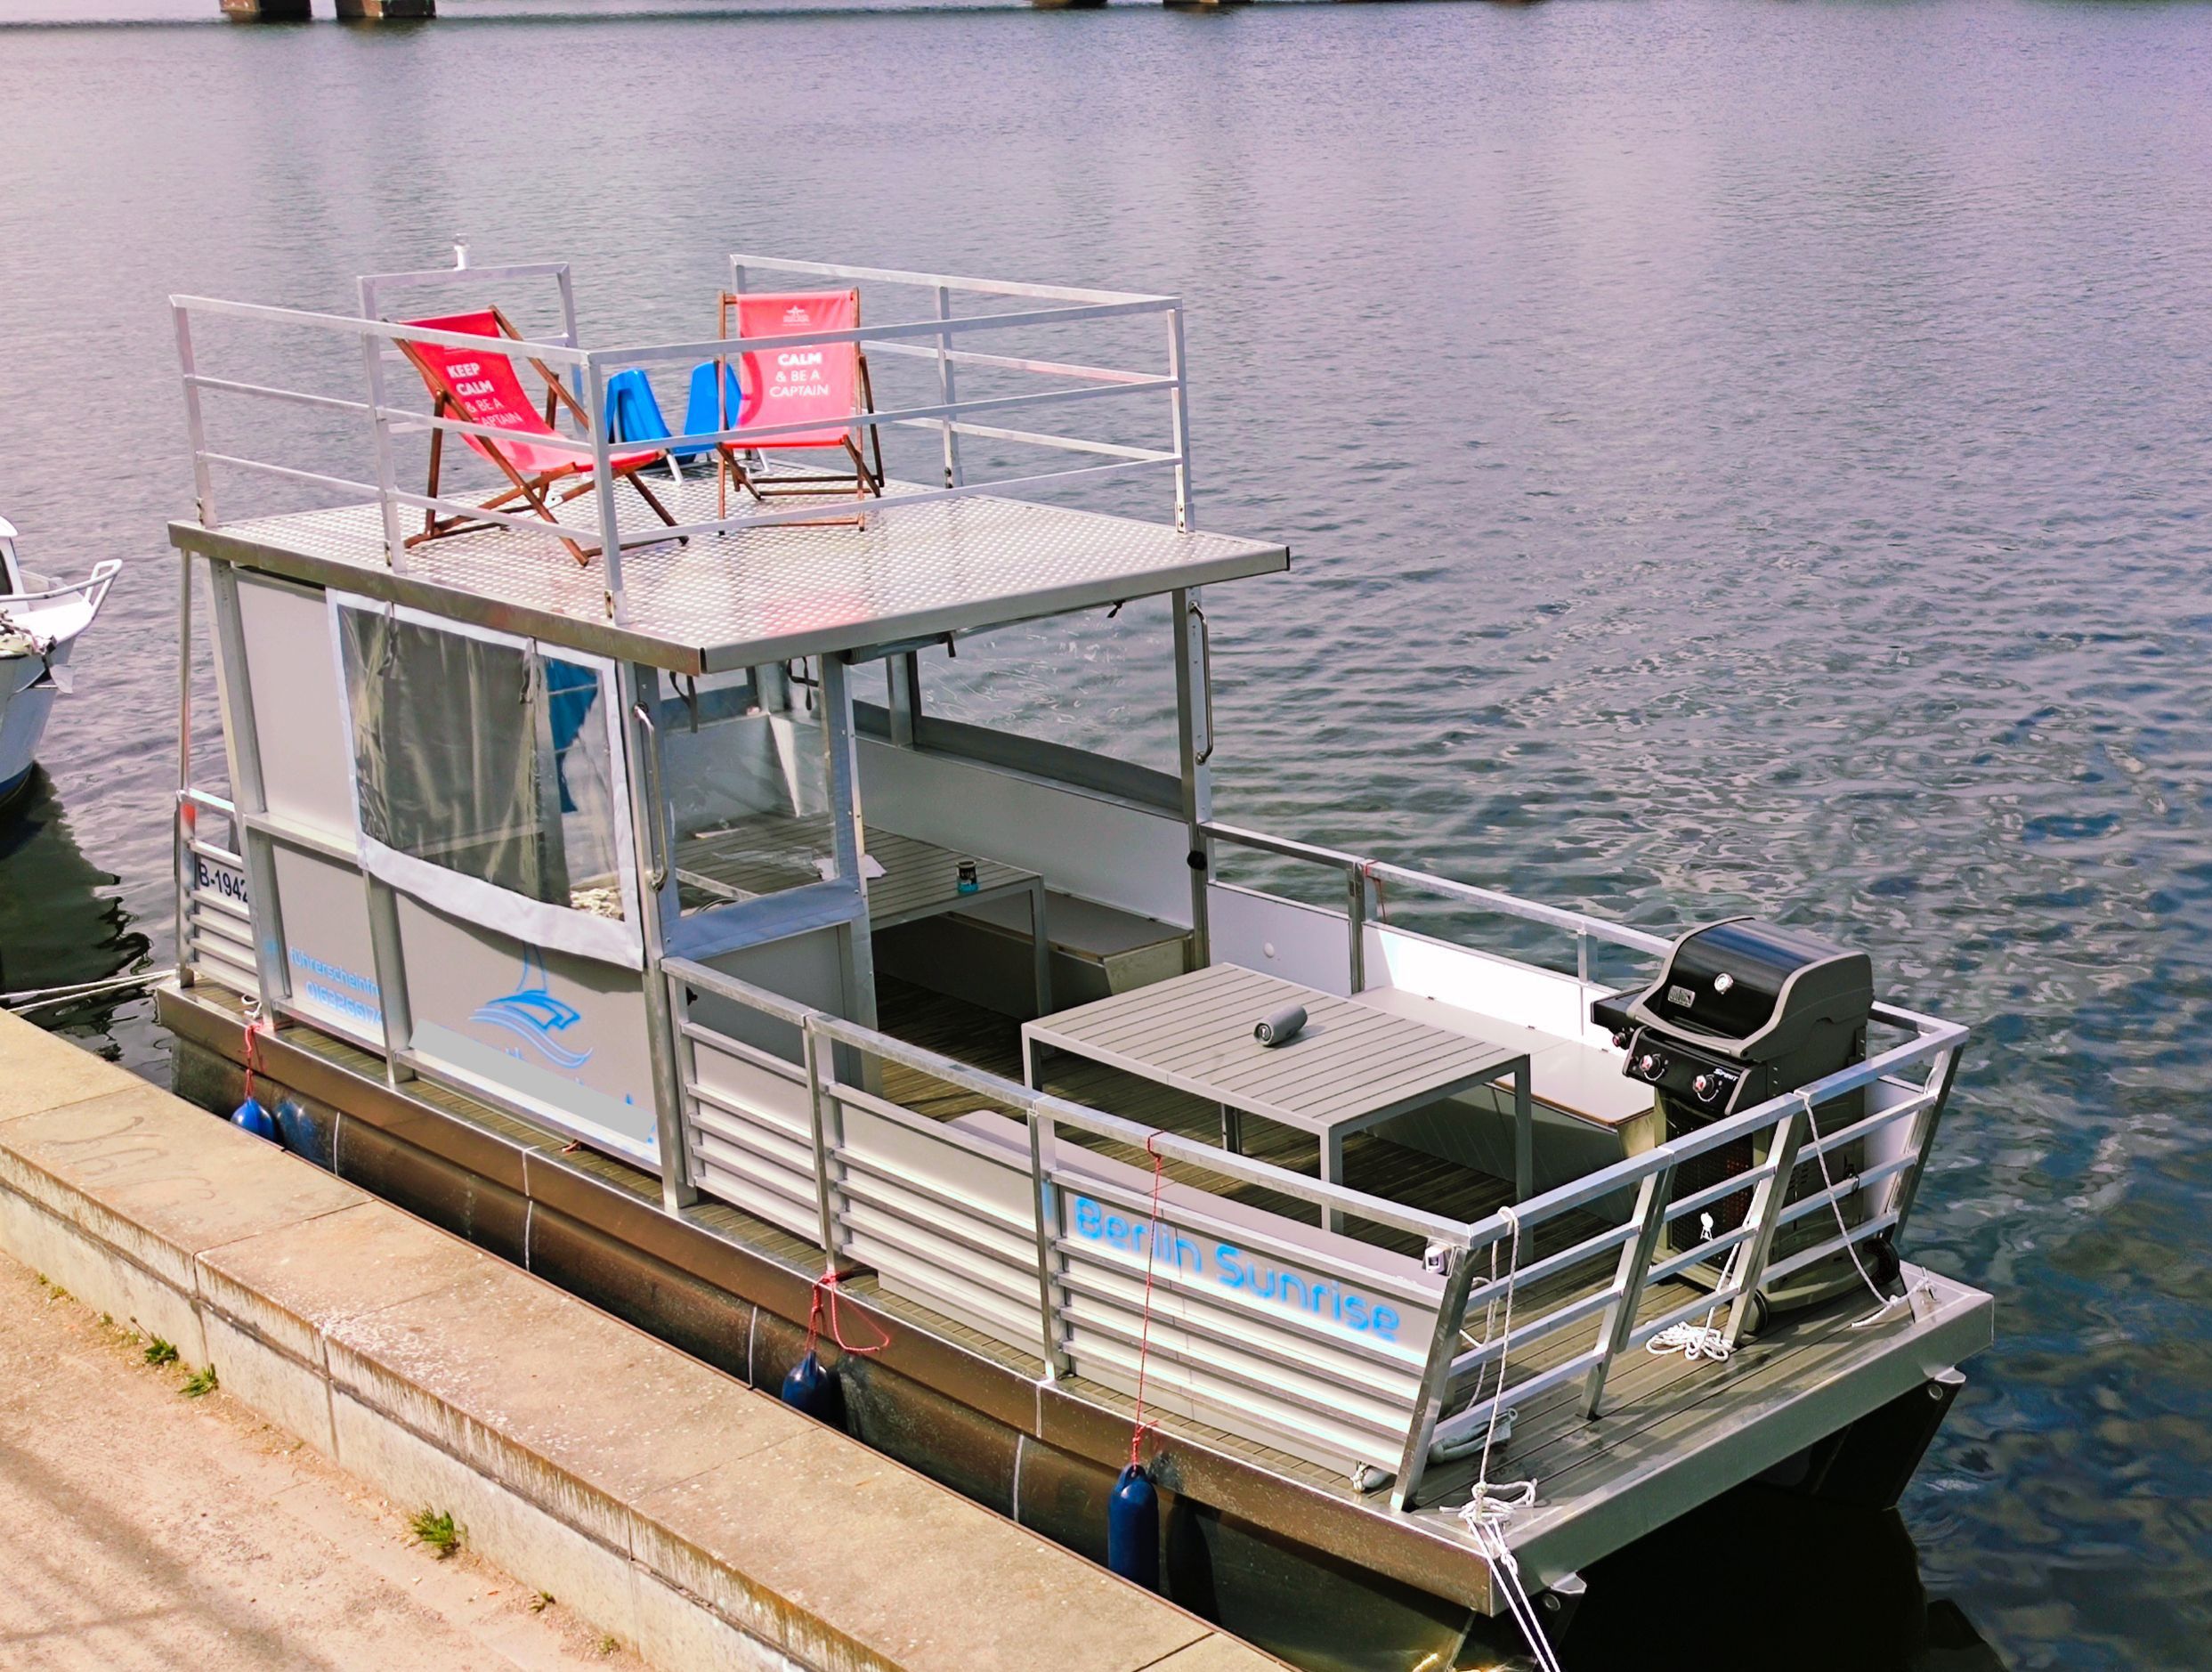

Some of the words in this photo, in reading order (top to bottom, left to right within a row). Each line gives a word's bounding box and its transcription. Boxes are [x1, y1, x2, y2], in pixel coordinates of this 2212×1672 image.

[777, 352, 822, 366] CALM
[446, 362, 480, 378] KEEP
[775, 370, 786, 382] &
[790, 369, 806, 382] BE
[810, 369, 821, 380] A
[456, 380, 494, 396] CALM
[769, 384, 830, 397] CAPTAIN
[465, 401, 477, 413] &
[474, 398, 492, 411] BE
[493, 397, 505, 409] A
[473, 411, 523, 427] APTAIN
[1074, 1195, 1203, 1274] Berlin
[1214, 1241, 1400, 1343] Sunrise
